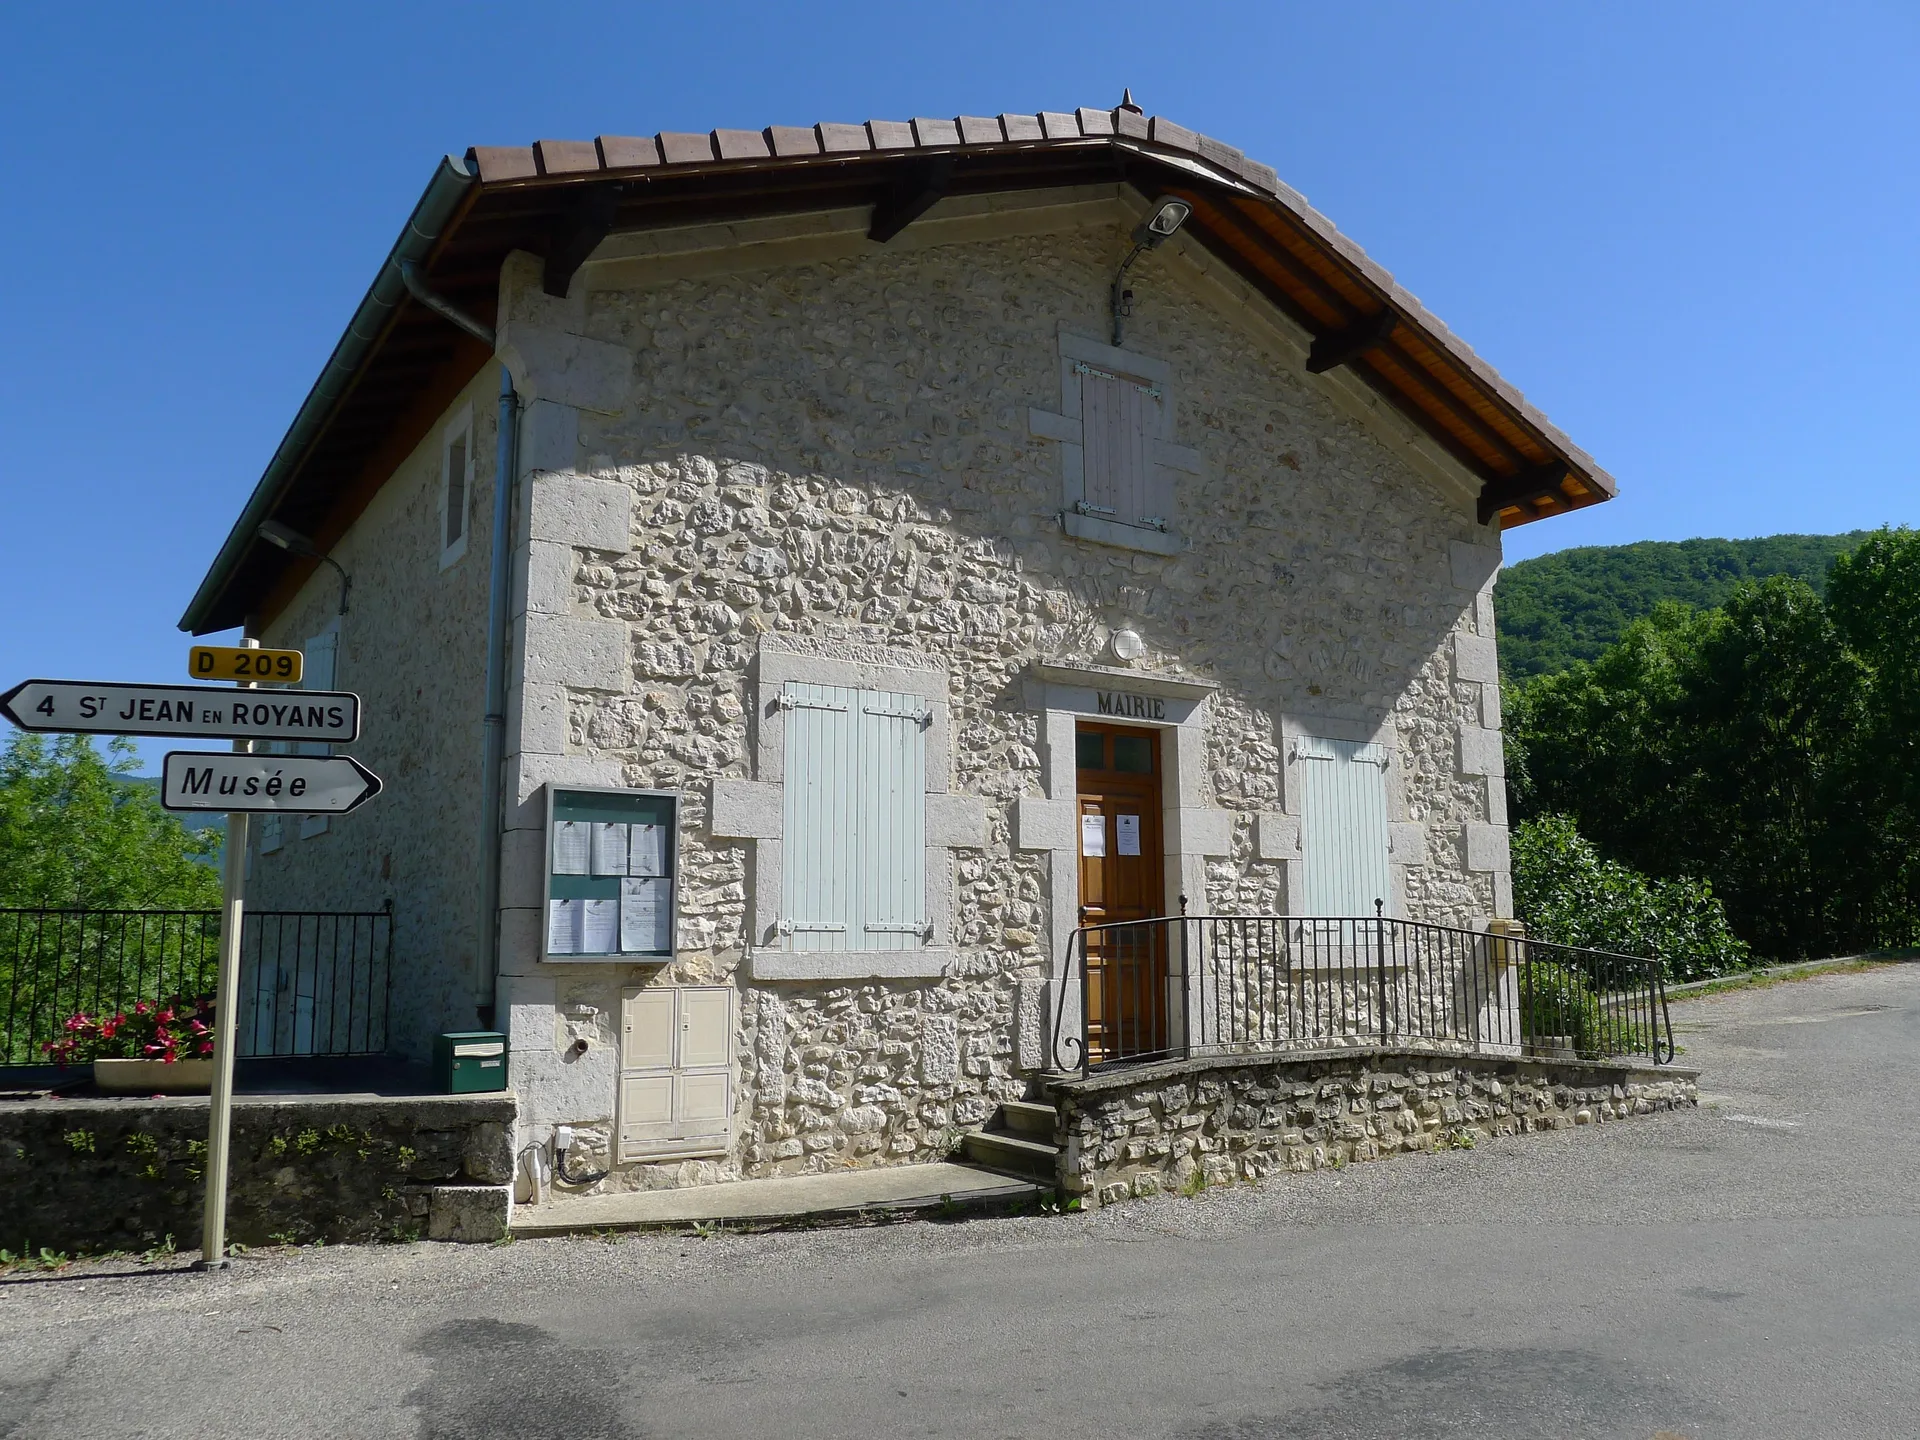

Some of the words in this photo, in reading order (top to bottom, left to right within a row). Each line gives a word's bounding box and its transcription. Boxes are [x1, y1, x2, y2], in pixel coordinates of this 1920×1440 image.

[197, 651, 214, 673] D
[234, 653, 293, 677] 209
[36, 695, 55, 717] 4
[119, 699, 193, 723] JEAN
[202, 709, 222, 724] EN
[232, 703, 345, 728] ROYANS
[1097, 691, 1165, 719] MAIRIE
[181, 767, 307, 797] Musée
